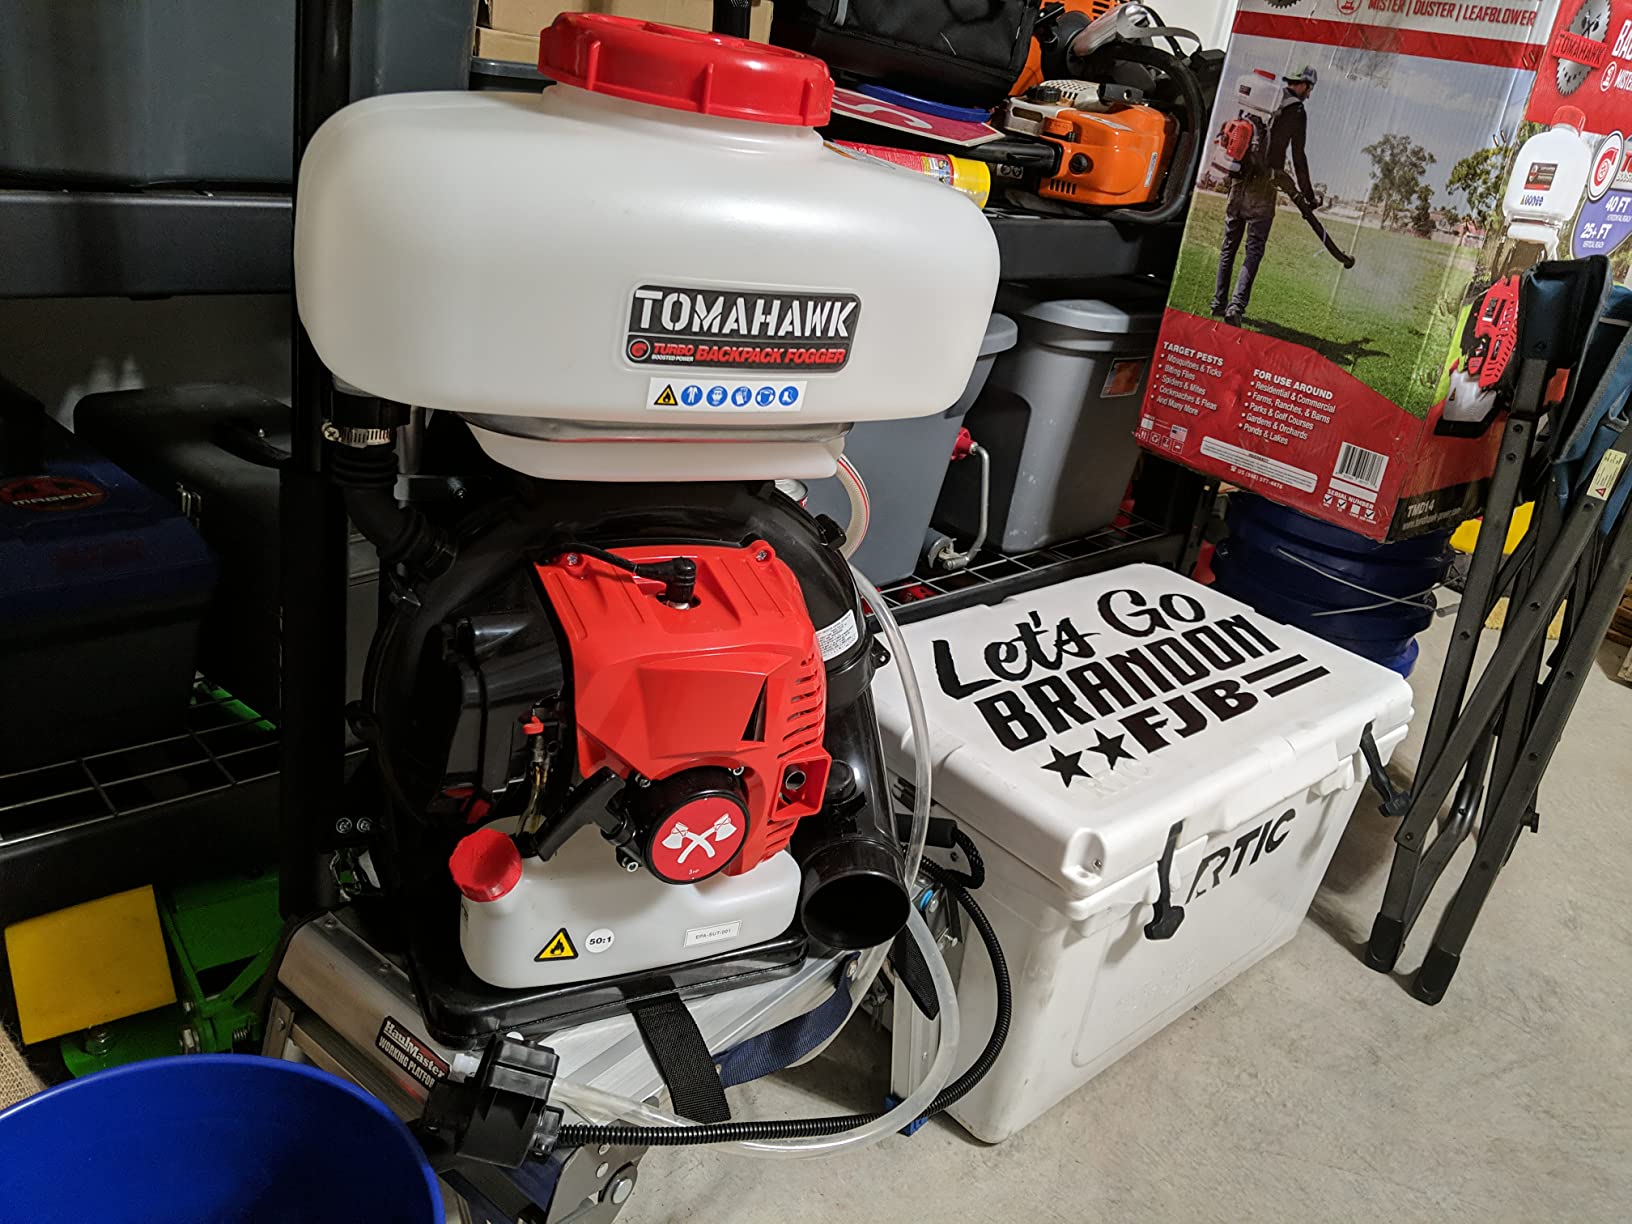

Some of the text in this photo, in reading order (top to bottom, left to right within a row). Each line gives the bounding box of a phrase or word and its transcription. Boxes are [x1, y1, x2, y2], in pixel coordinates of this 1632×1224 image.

[1413, 0, 1454, 19] DUSTER
[1462, 4, 1537, 26] LEAFBLOWER
[1616, 197, 1632, 212] FT
[1597, 224, 1613, 239] FT
[635, 289, 858, 338] TOMAHAWK
[653, 342, 847, 365] TURBO BACKPACK FOGGER
[1163, 341, 1224, 367] TARGET PESTS
[1253, 369, 1333, 400] FOR USE AROUND
[1255, 381, 1290, 398] Residential
[1297, 394, 1336, 413] Commercial
[1246, 413, 1271, 428] Gardens
[1279, 423, 1308, 440] Orchards
[1249, 402, 1267, 414] Parks
[1274, 410, 1287, 421] Golf
[1288, 415, 1314, 430] Courses
[1311, 411, 1331, 424] Barns
[1243, 423, 1262, 436] Ponds
[1269, 432, 1289, 445] Lakes
[1327, 488, 1374, 510] SERIAL NUMBER
[933, 610, 1101, 700] Let's
[1097, 588, 1207, 638] Go
[974, 613, 1281, 751] BRANDON
[1118, 679, 1259, 754] FJB
[589, 936, 612, 946] 50:1
[378, 1036, 436, 1089] WORKING PLATFOR
[384, 1020, 446, 1078] HaulMaster
